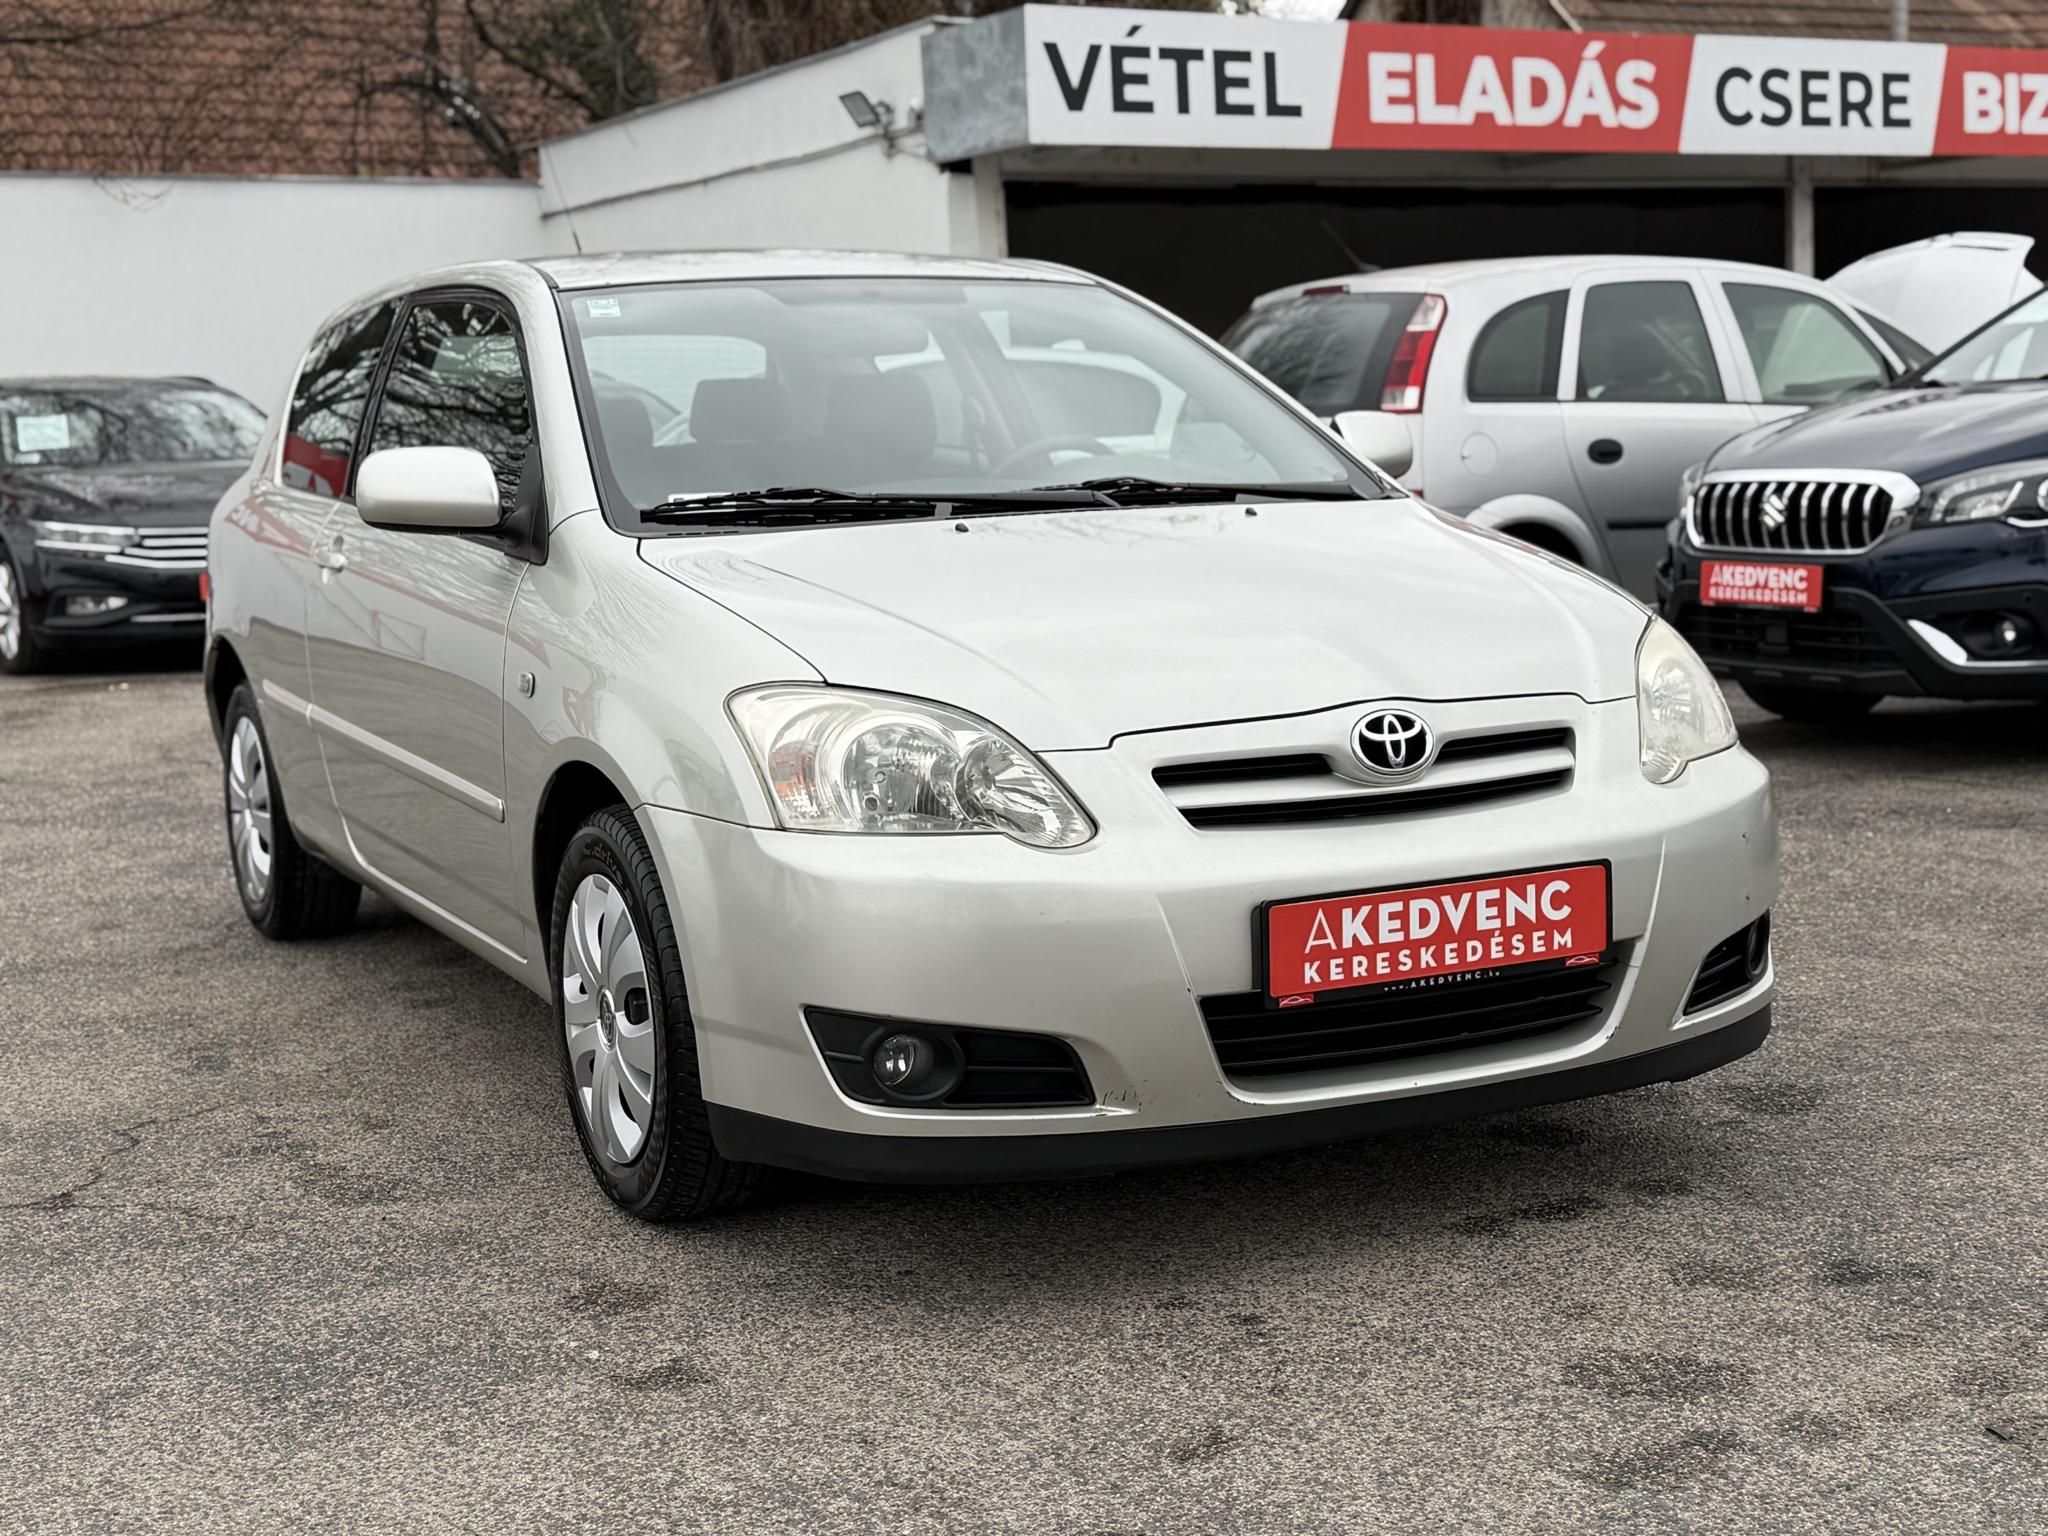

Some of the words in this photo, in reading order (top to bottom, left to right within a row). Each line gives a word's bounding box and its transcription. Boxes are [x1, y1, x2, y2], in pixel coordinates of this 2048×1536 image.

[1043, 24, 1303, 118] VÉTEL
[1367, 40, 1660, 129] ELADÁS
[1715, 66, 1911, 128] CSERE
[1304, 927, 1573, 985] KERESKEDÉSEM
